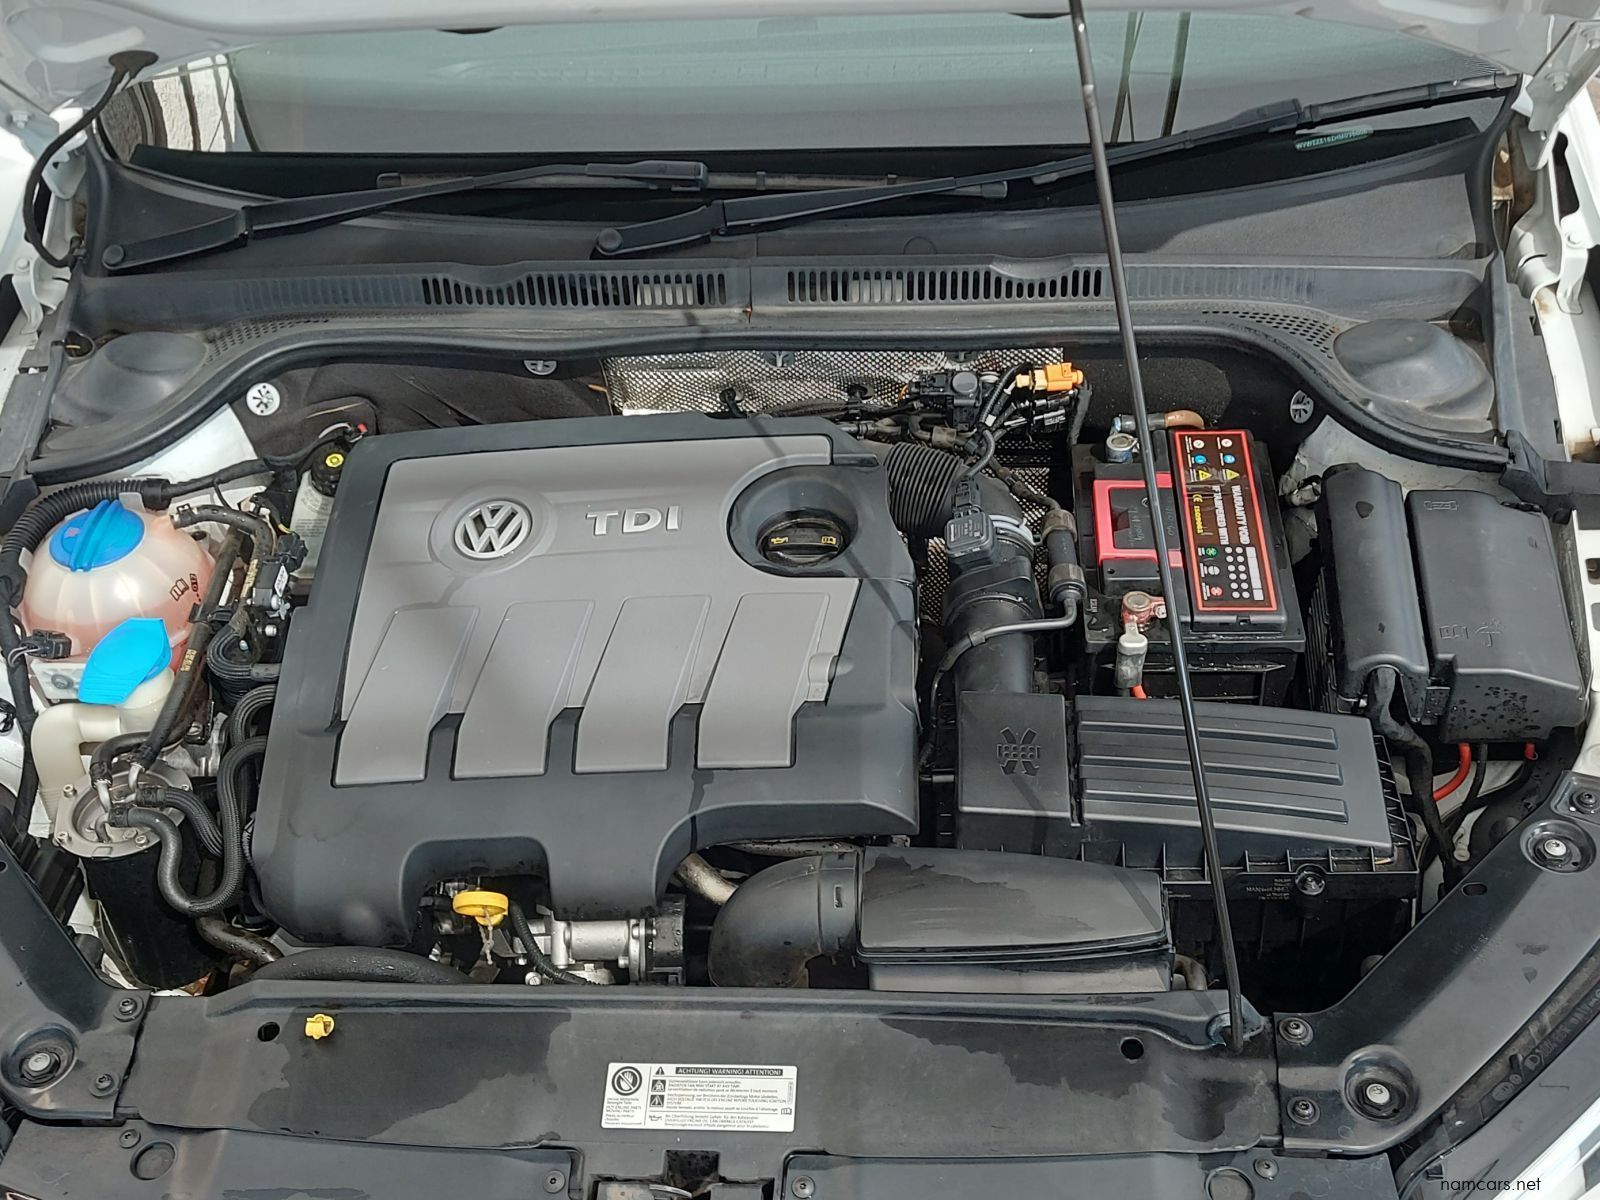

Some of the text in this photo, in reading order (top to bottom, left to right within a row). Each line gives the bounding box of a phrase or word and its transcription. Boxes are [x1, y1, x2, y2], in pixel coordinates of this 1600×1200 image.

[586, 505, 680, 536] TDI
[1211, 485, 1229, 545] IF TAMPERED WITH
[1231, 485, 1250, 545] WARRANTY VOID
[677, 1067, 782, 1076] ACHTUNG! WARNING! ATTENTION!
